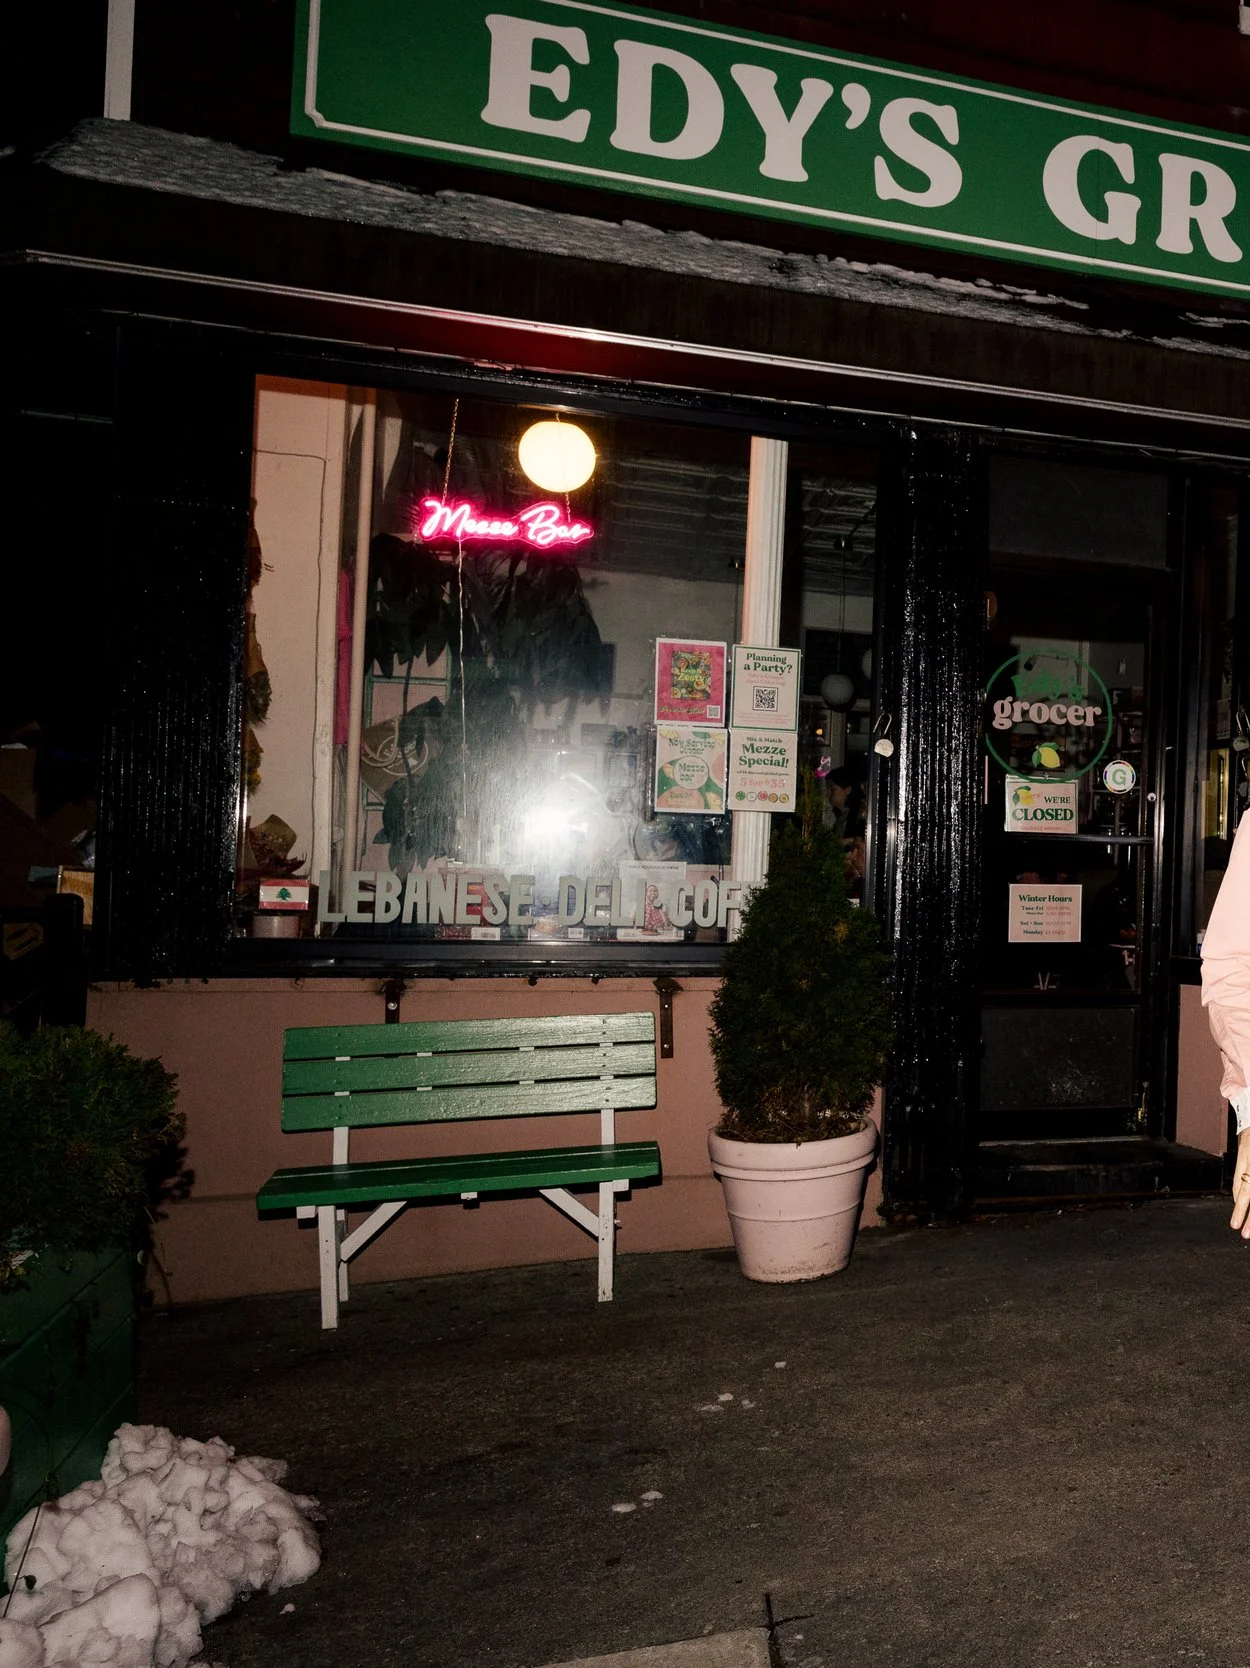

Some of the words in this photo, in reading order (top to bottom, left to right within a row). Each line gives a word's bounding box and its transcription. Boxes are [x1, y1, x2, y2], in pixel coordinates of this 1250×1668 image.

[480, 12, 963, 208] EDY’S
[421, 499, 519, 538] Mezze
[520, 505, 591, 545] Bar
[746, 653, 787, 665] Planning
[743, 663, 751, 671] a
[753, 662, 793, 676] Party?
[992, 695, 1103, 731] grocer
[742, 743, 787, 756] Mezze
[738, 755, 790, 769] Special!
[1111, 768, 1127, 785] G
[1043, 796, 1071, 804] WE'RE
[1011, 807, 1074, 822] CLOSED
[318, 869, 537, 926] LEBANESE
[557, 874, 647, 928] DELI
[1018, 894, 1048, 902] Winter
[1048, 894, 1073, 903] Hours
